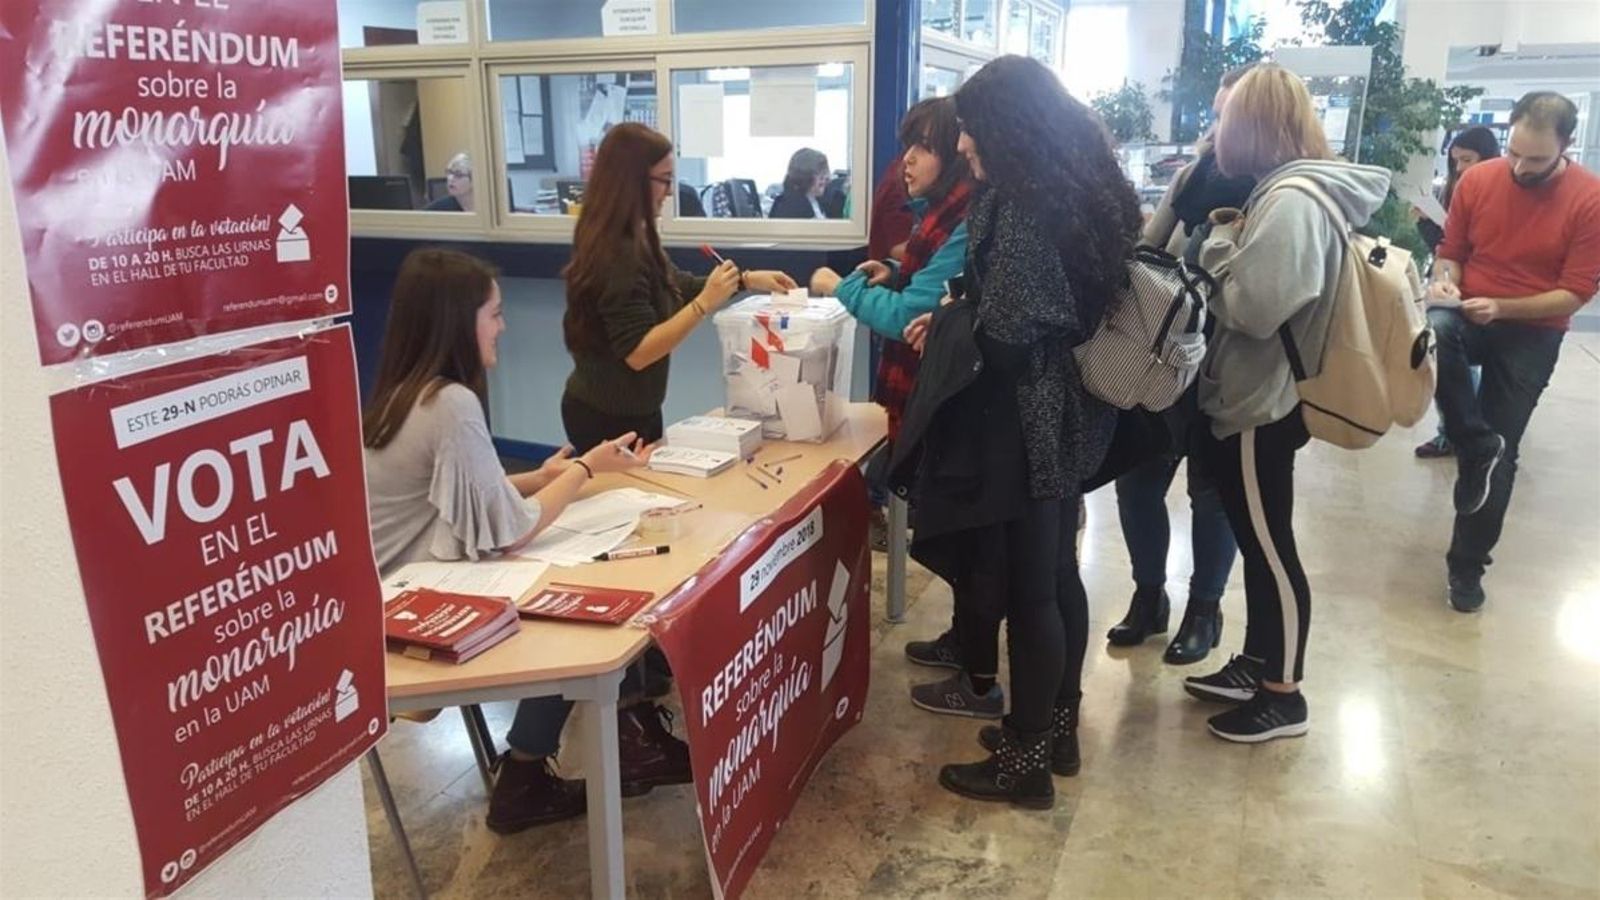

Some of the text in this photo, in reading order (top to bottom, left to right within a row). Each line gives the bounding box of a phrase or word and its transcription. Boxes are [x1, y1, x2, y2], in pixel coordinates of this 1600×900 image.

[138, 70, 237, 99] sobre la
[73, 99, 296, 171] monarquía
[147, 159, 196, 182] AM
[88, 239, 271, 271] DE 10 A 20 H. BUSCA LAS URNAS
[171, 226, 187, 240] en
[191, 220, 205, 237] la
[210, 214, 271, 236] votación!
[91, 255, 250, 286] EN EL HALL DE TU FACULTAD
[127, 368, 302, 433] ESTE 29-N PODRÁS OPINAR
[112, 418, 331, 545] VOTA
[201, 512, 278, 566] EN EL
[750, 520, 815, 591] 29 noviembre 2018
[144, 530, 338, 645] REFERÉNDUM
[214, 589, 296, 643] sobre la
[167, 594, 345, 713] monarquía
[702, 578, 817, 727] REFERÉNDUM
[174, 674, 270, 743] en la UAM
[736, 653, 784, 722] sobre la
[180, 745, 247, 791] Participa
[249, 733, 263, 750] en
[267, 723, 280, 739] la
[184, 793, 200, 810] DE
[202, 783, 213, 798] 10
[215, 777, 224, 789] A
[225, 766, 238, 782] 20
[252, 739, 284, 764] BUSCA
[285, 727, 303, 744] LAS
[710, 655, 813, 816] monarquía
[186, 804, 201, 822] EN
[202, 797, 214, 811] EL
[240, 770, 253, 785] DE
[254, 760, 268, 774] TU
[270, 730, 317, 765] FACULTAD
[712, 758, 761, 854] en la UAM
